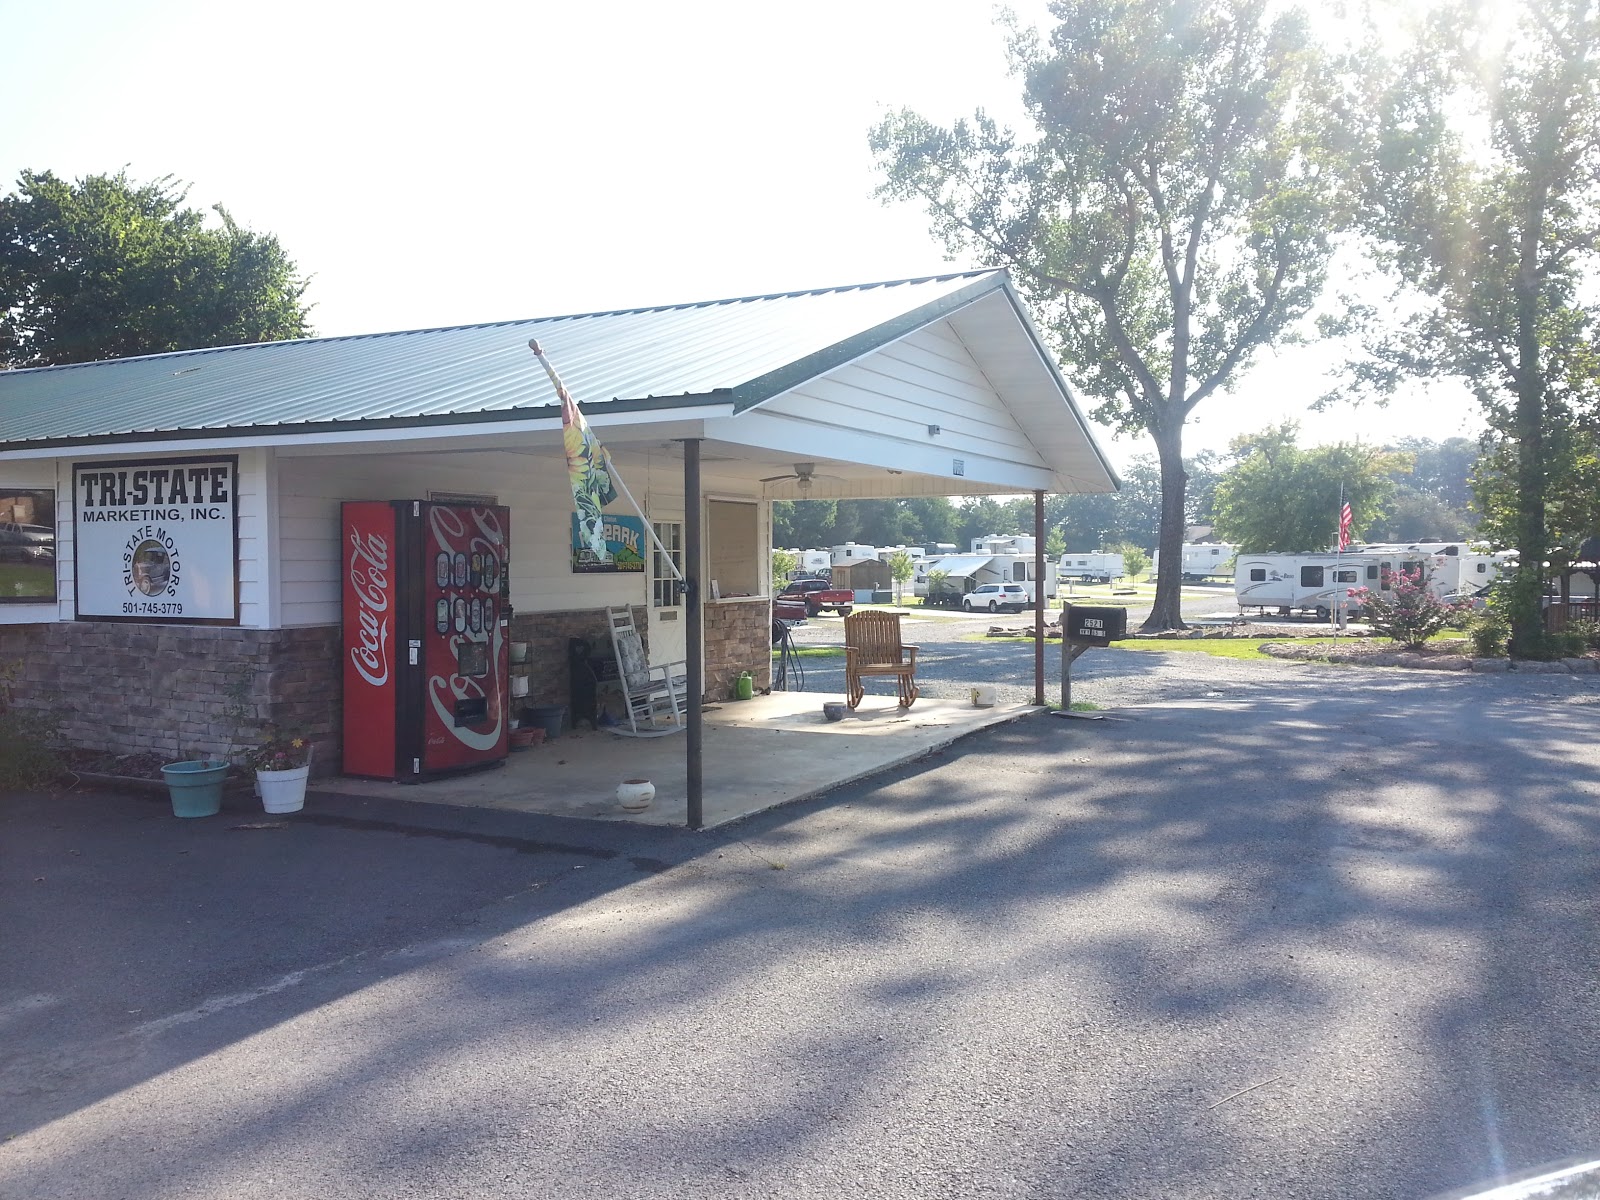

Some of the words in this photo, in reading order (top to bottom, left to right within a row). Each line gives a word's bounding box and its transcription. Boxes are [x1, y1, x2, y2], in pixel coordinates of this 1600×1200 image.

[80, 467, 228, 507] TRI-STATE
[83, 508, 185, 523] MARKETING,
[190, 507, 226, 520] INC.
[123, 525, 153, 597] TRI-STATE
[156, 527, 181, 597] MOTORS
[122, 602, 183, 614] 501-745-3779
[350, 524, 388, 686] Coca-Cola
[1086, 619, 1102, 628] 2521
